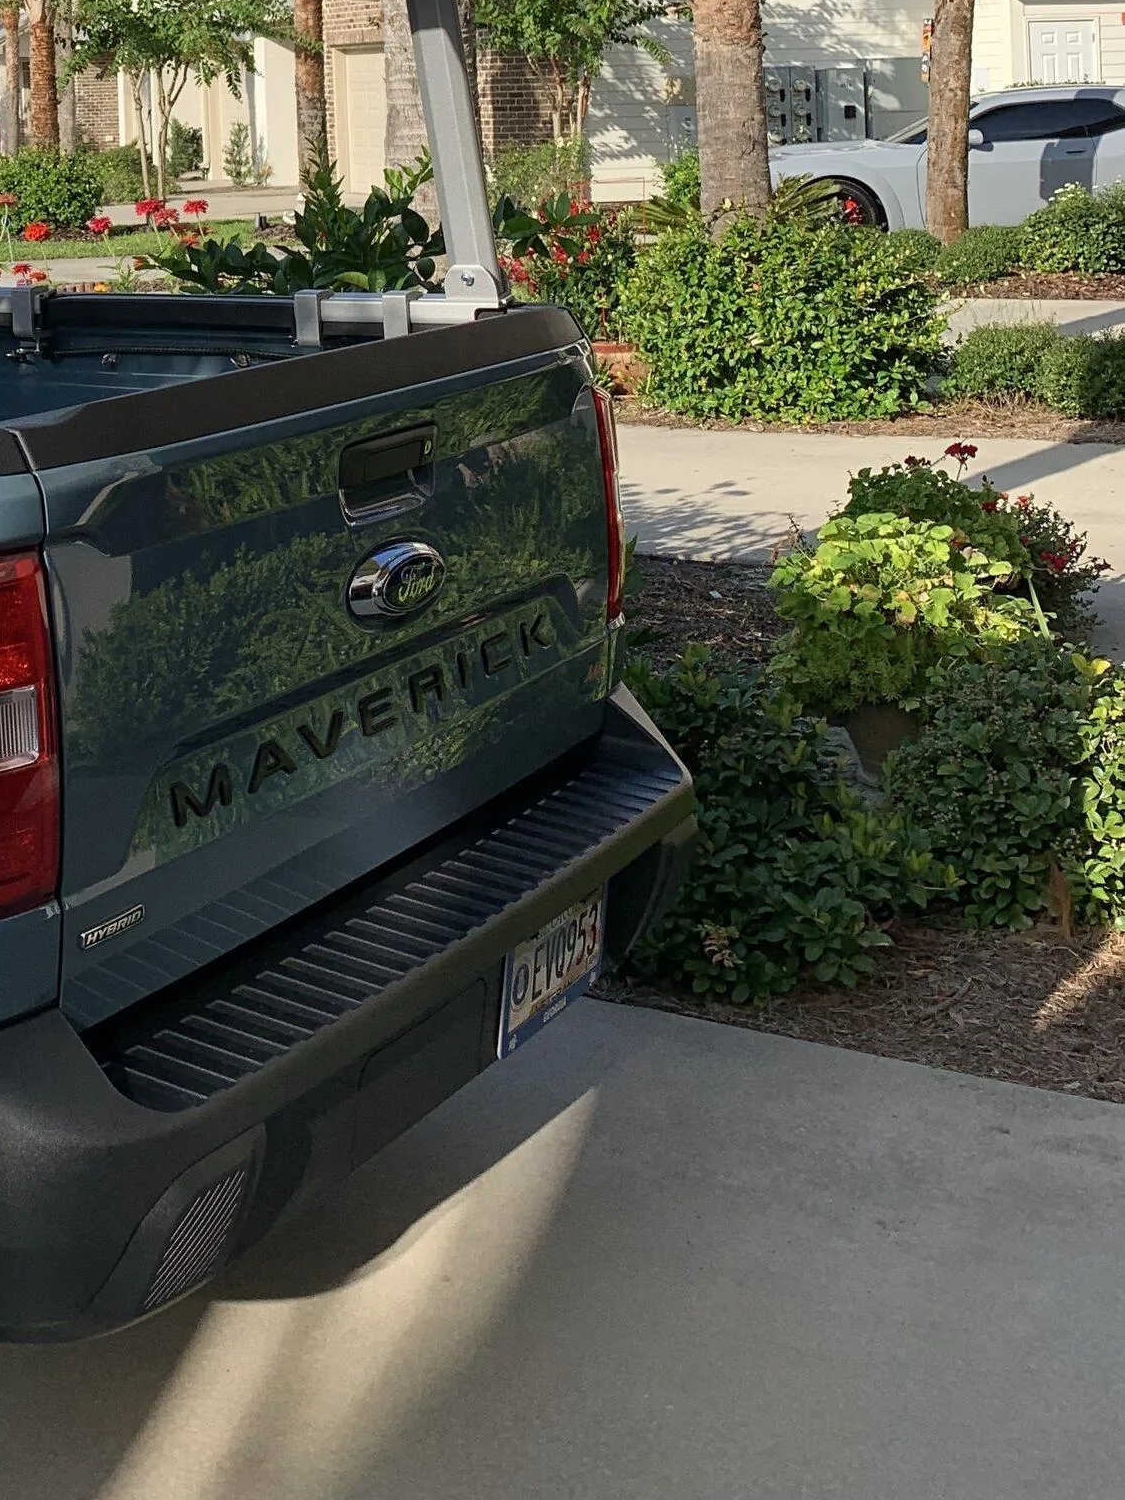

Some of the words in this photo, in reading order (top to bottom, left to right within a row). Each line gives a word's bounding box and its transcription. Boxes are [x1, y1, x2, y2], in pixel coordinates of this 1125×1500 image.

[398, 562, 435, 603] Ford
[169, 612, 558, 829] MAVERICK
[86, 910, 143, 946] HYBRID
